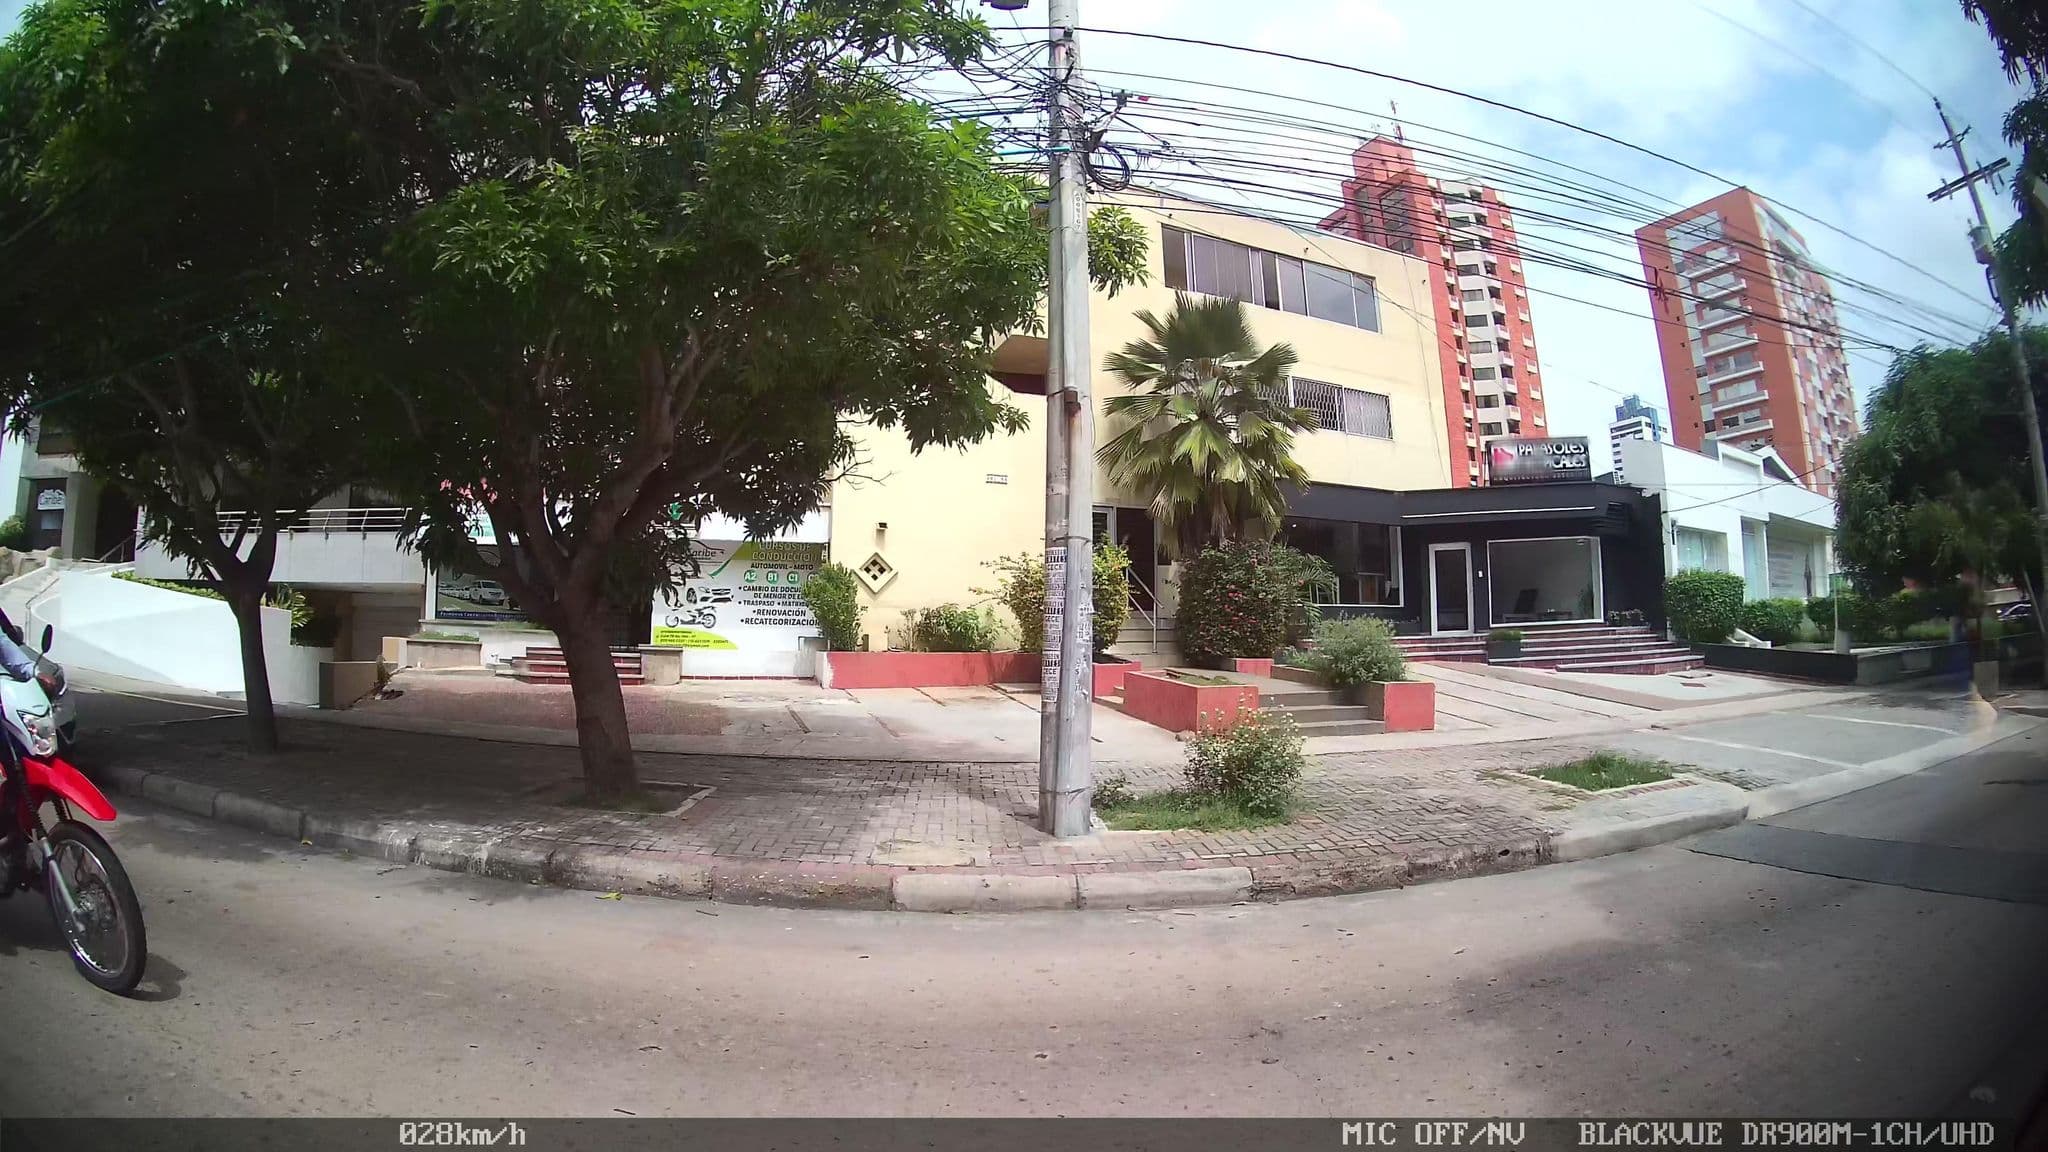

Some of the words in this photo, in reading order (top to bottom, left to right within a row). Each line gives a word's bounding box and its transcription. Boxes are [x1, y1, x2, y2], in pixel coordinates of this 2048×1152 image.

[1518, 442, 1585, 455] PAASOLES
[793, 563, 814, 571] MOTO
[745, 573, 757, 581] A2
[767, 573, 778, 582] B1
[787, 574, 798, 582] C1
[743, 599, 775, 607] TRASPASO
[756, 607, 807, 617] RENOVACIÓN
